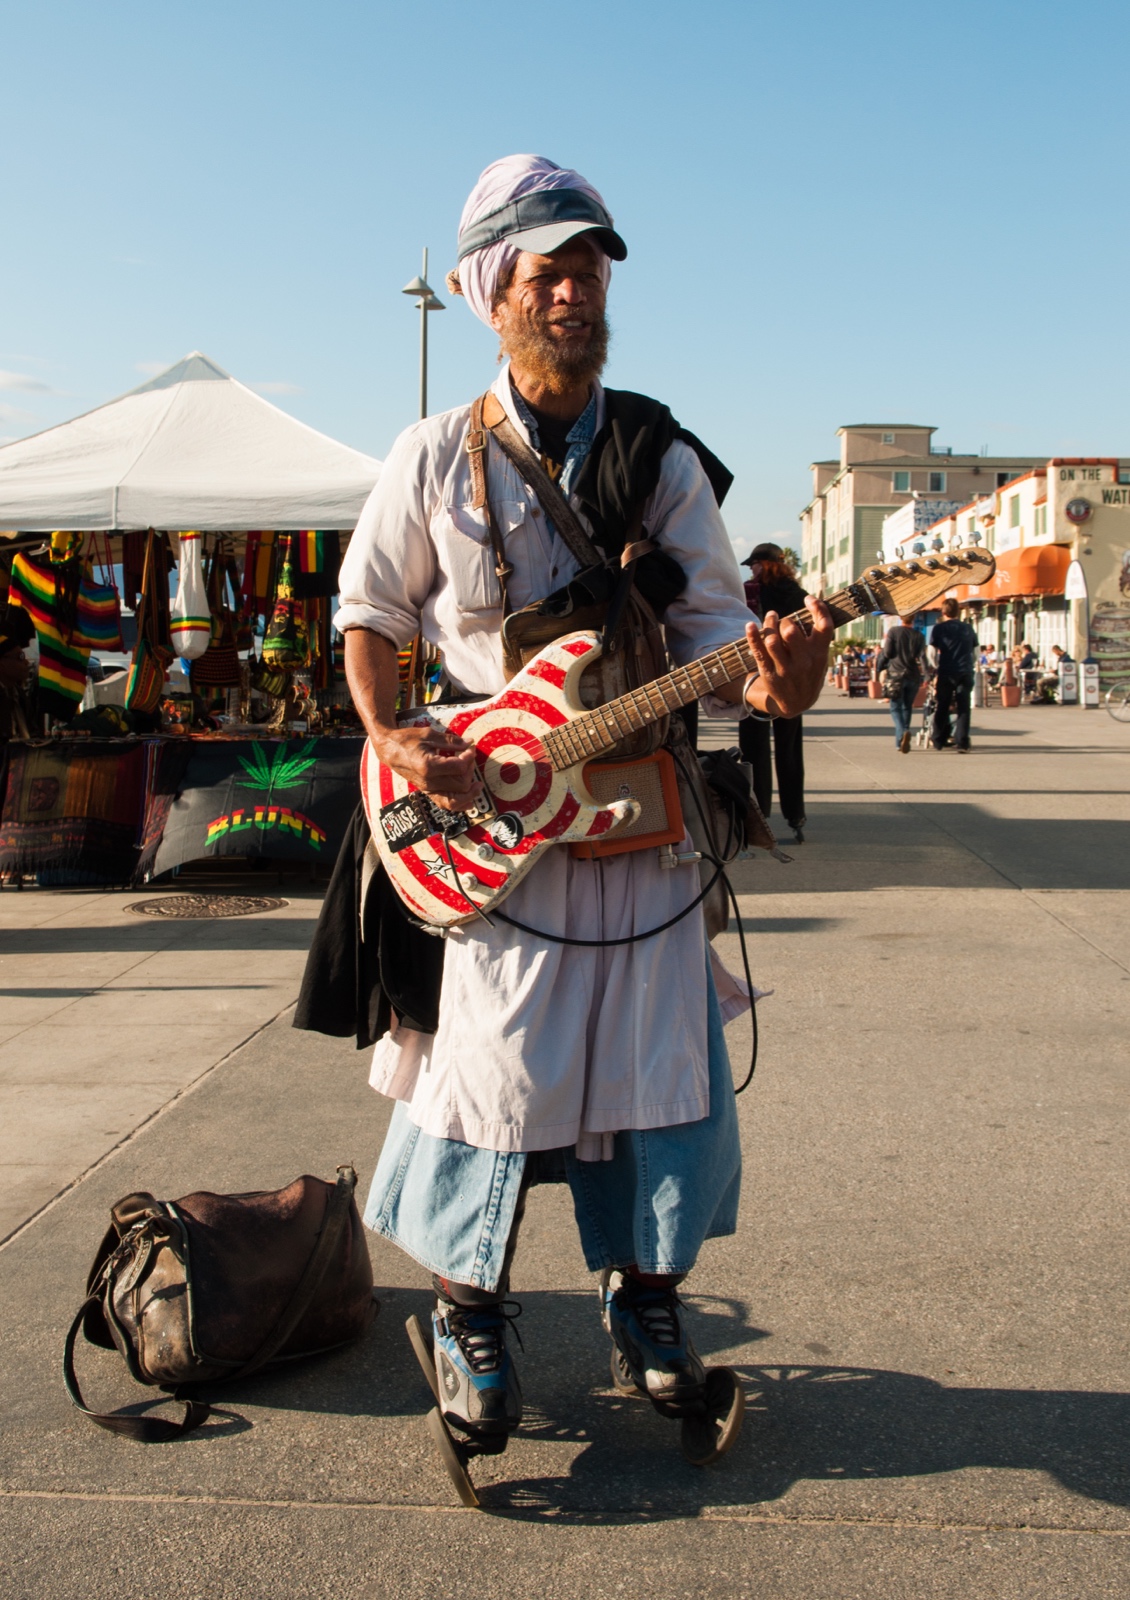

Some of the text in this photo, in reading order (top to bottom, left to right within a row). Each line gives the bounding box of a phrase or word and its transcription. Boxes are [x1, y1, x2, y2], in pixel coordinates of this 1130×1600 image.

[1060, 469, 1101, 481] ON THE
[1102, 489, 1130, 504] WAT
[205, 806, 327, 851] BLUNT
